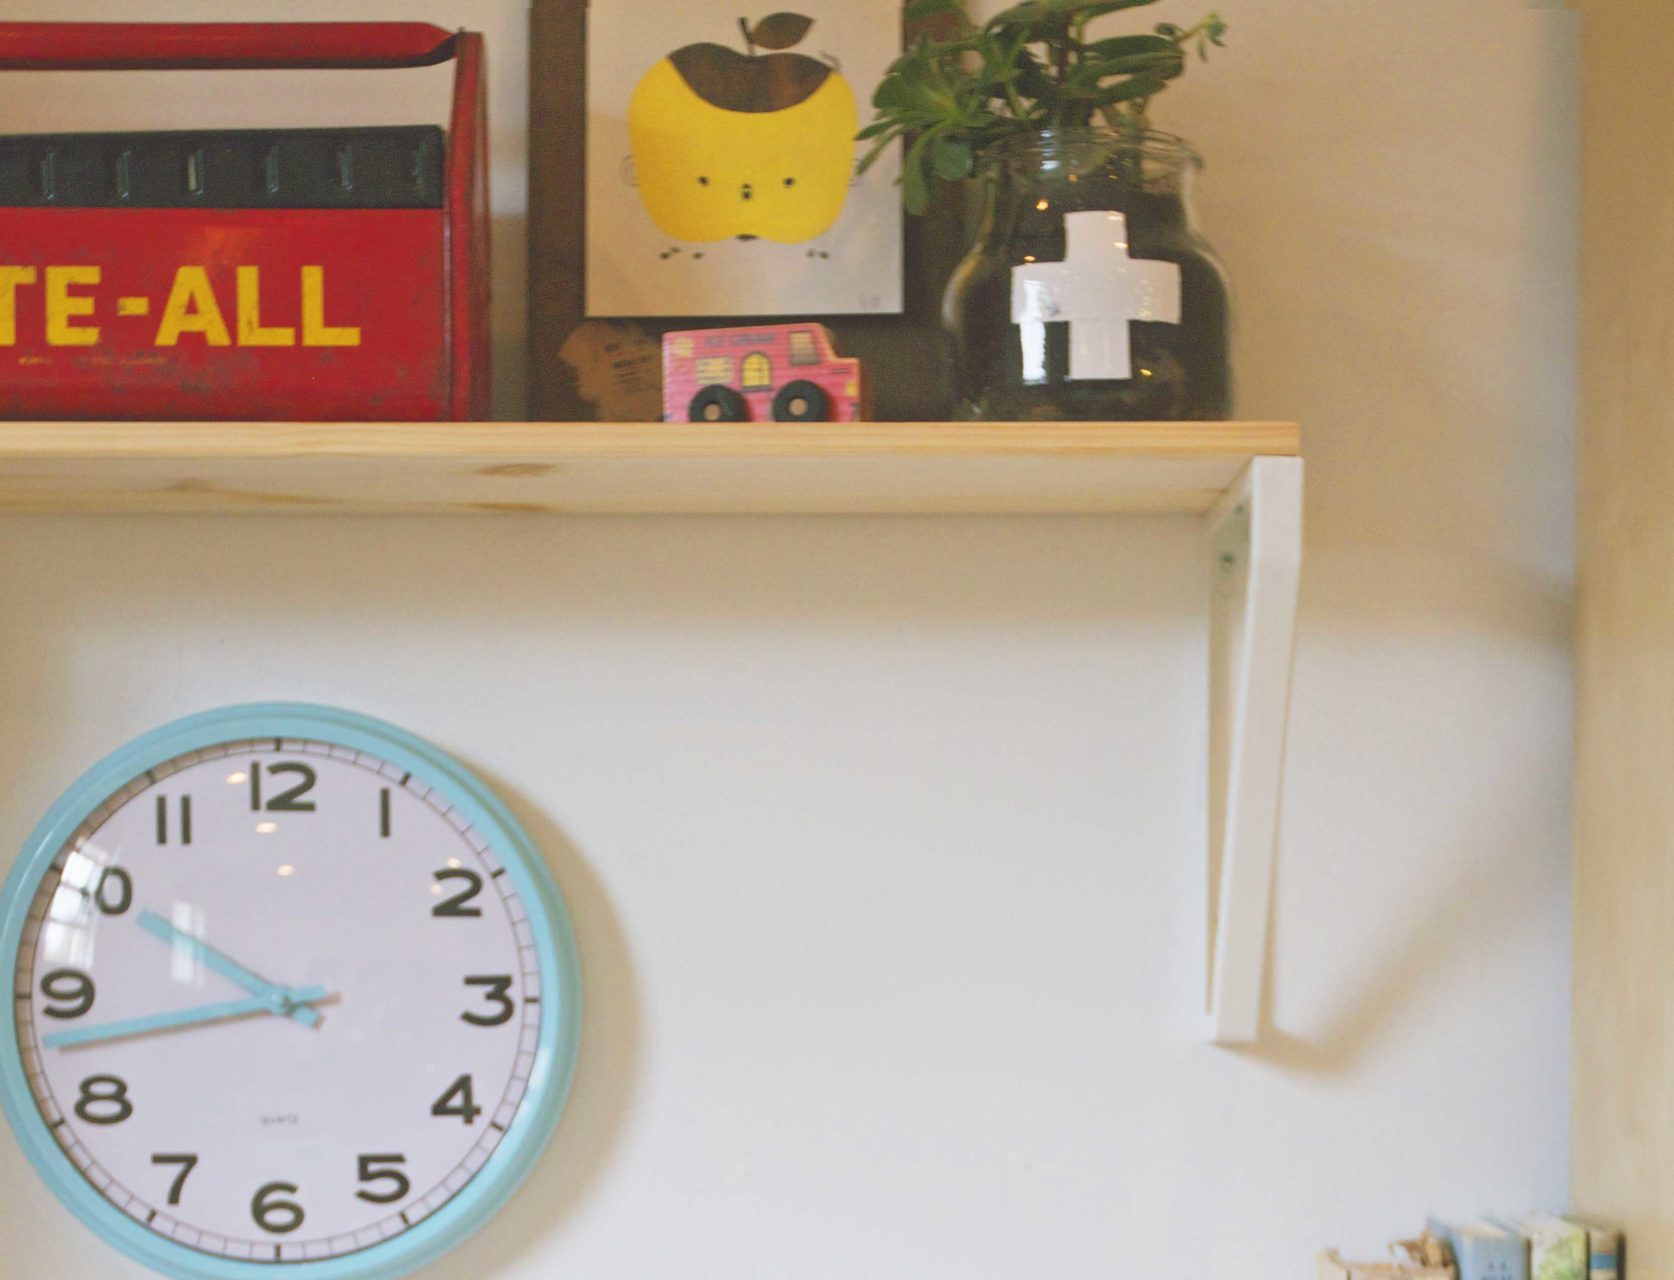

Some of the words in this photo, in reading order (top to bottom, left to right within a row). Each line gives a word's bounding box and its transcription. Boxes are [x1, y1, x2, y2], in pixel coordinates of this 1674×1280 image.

[0, 265, 361, 346] TE-ALL
[249, 761, 317, 813] 12
[380, 787, 391, 838] 1
[156, 795, 192, 845] 11
[79, 866, 133, 916] 0
[431, 868, 483, 917] 2
[40, 969, 95, 1019] 9
[460, 975, 514, 1027] 3
[74, 1074, 133, 1125] 8
[430, 1074, 481, 1124] 4
[151, 1154, 198, 1205] 7
[355, 1154, 411, 1204] 5
[250, 1182, 305, 1234] 6
